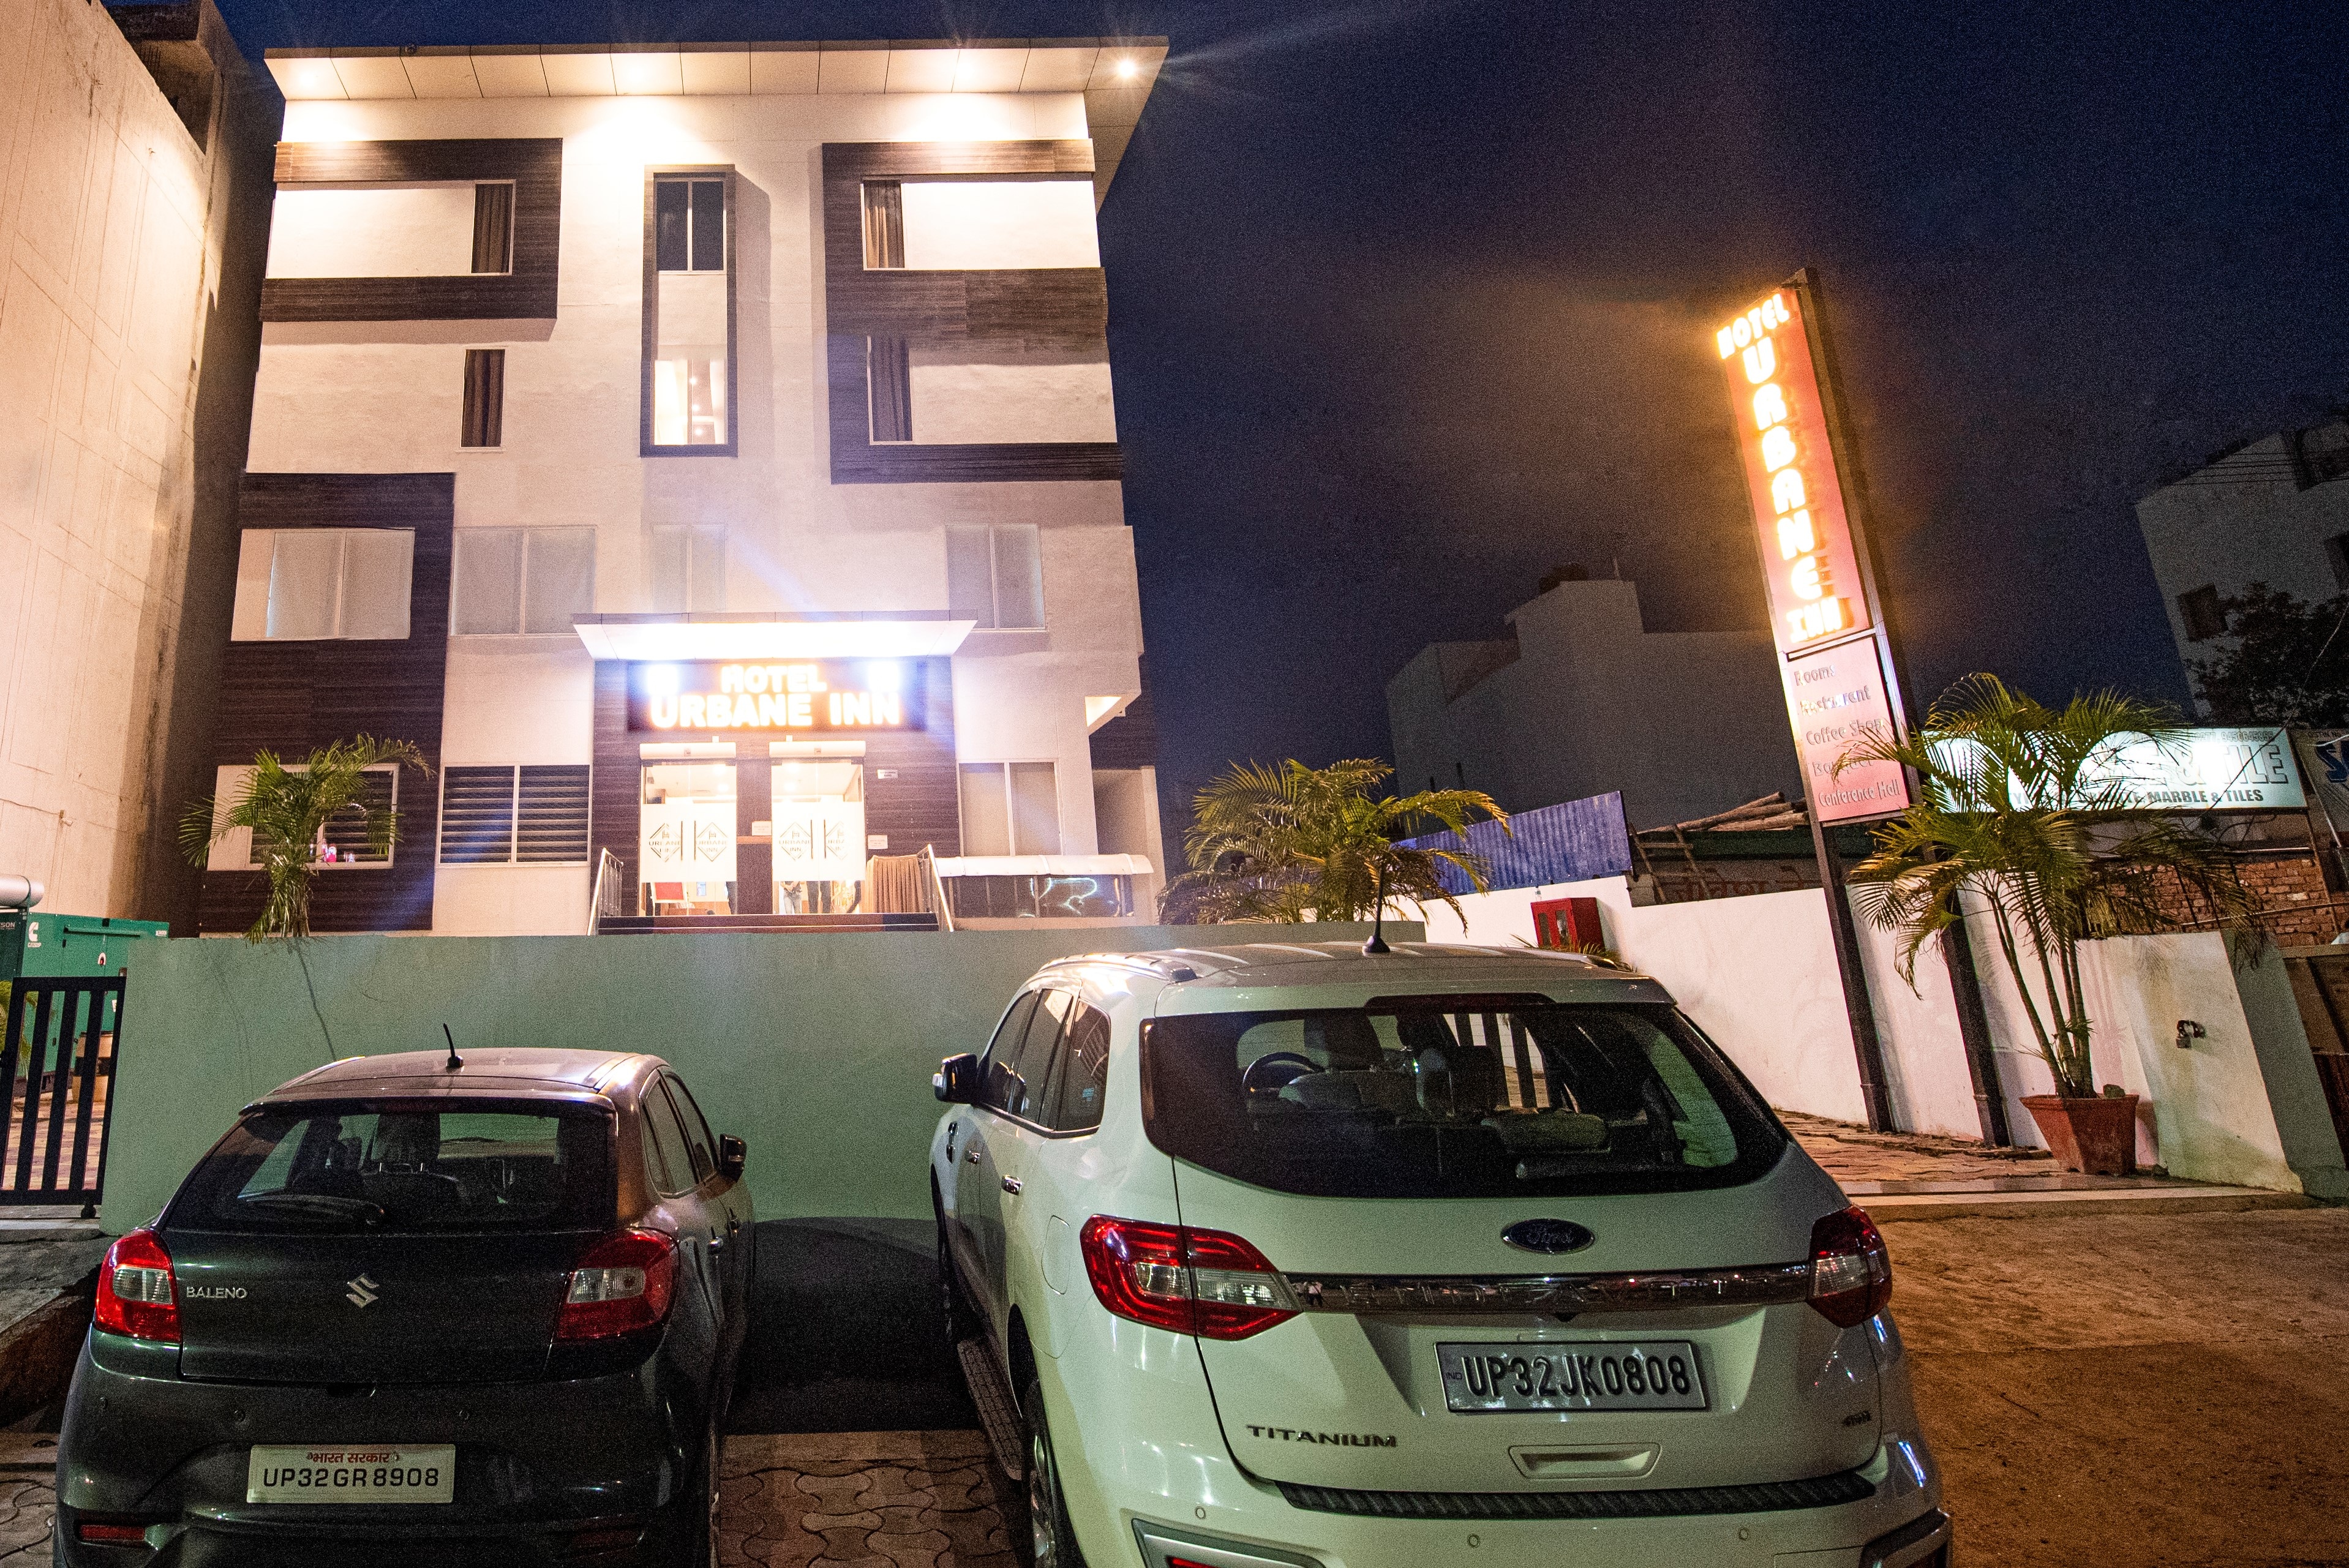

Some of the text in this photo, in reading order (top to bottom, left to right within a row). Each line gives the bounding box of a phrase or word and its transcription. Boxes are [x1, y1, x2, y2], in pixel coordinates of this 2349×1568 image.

[1717, 293, 1790, 359] HOTEL
[1742, 336, 1823, 600] URBANE
[1786, 596, 1843, 643] INN
[721, 664, 827, 693] HOTEL
[1794, 664, 1836, 686] Rooms
[650, 692, 900, 728] URBANE INN
[1806, 718, 1884, 745] Coffee Shop
[2213, 745, 2289, 784] TILE
[1819, 779, 1900, 808] Conference Hall
[2149, 790, 2208, 803] MARBLE
[2211, 791, 2222, 802] &
[2227, 789, 2264, 802] TILES
[186, 1286, 247, 1299] BALENO
[1461, 1354, 1691, 1397] UP32JK0808
[1246, 1424, 1397, 1447] TITANIUM
[313, 1452, 391, 1463] भारत सरकार
